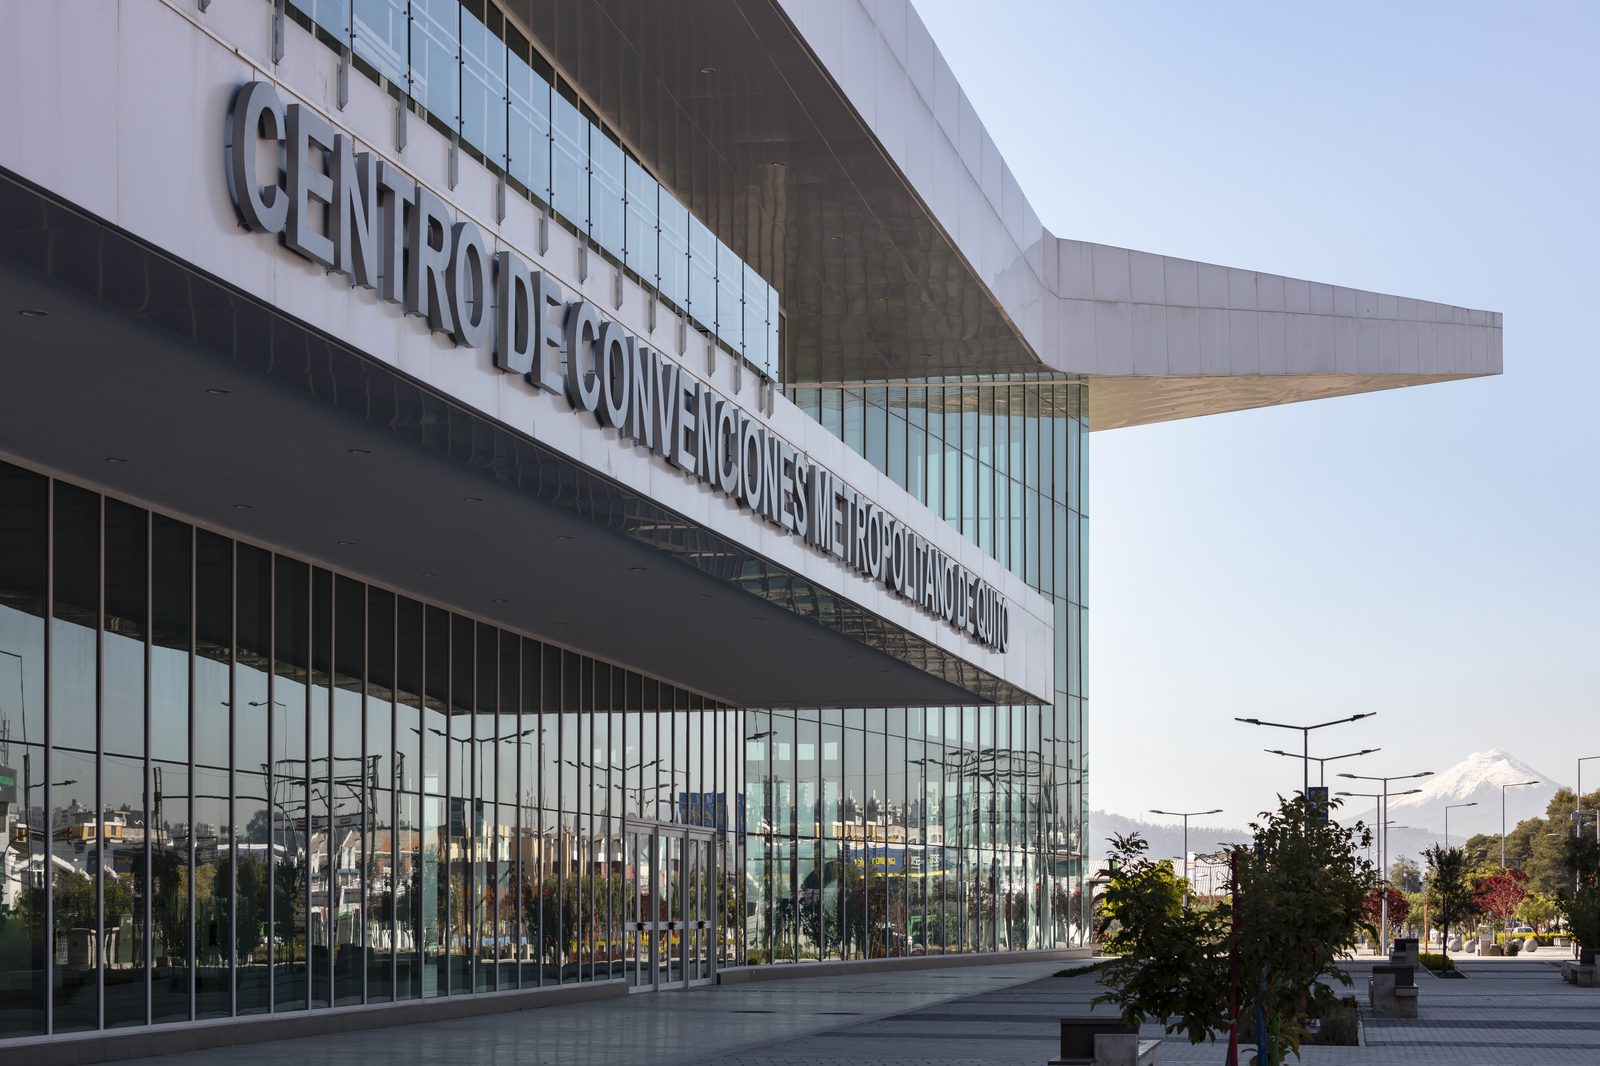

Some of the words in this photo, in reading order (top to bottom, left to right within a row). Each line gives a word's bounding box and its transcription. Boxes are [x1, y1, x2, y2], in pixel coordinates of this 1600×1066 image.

[231, 81, 490, 348] CENTRO
[500, 250, 563, 395] DE
[567, 301, 808, 537] CONVENCIONES
[809, 464, 955, 622] METROPOLITANO
[954, 564, 975, 635] DE
[974, 578, 1009, 655] QUITO
